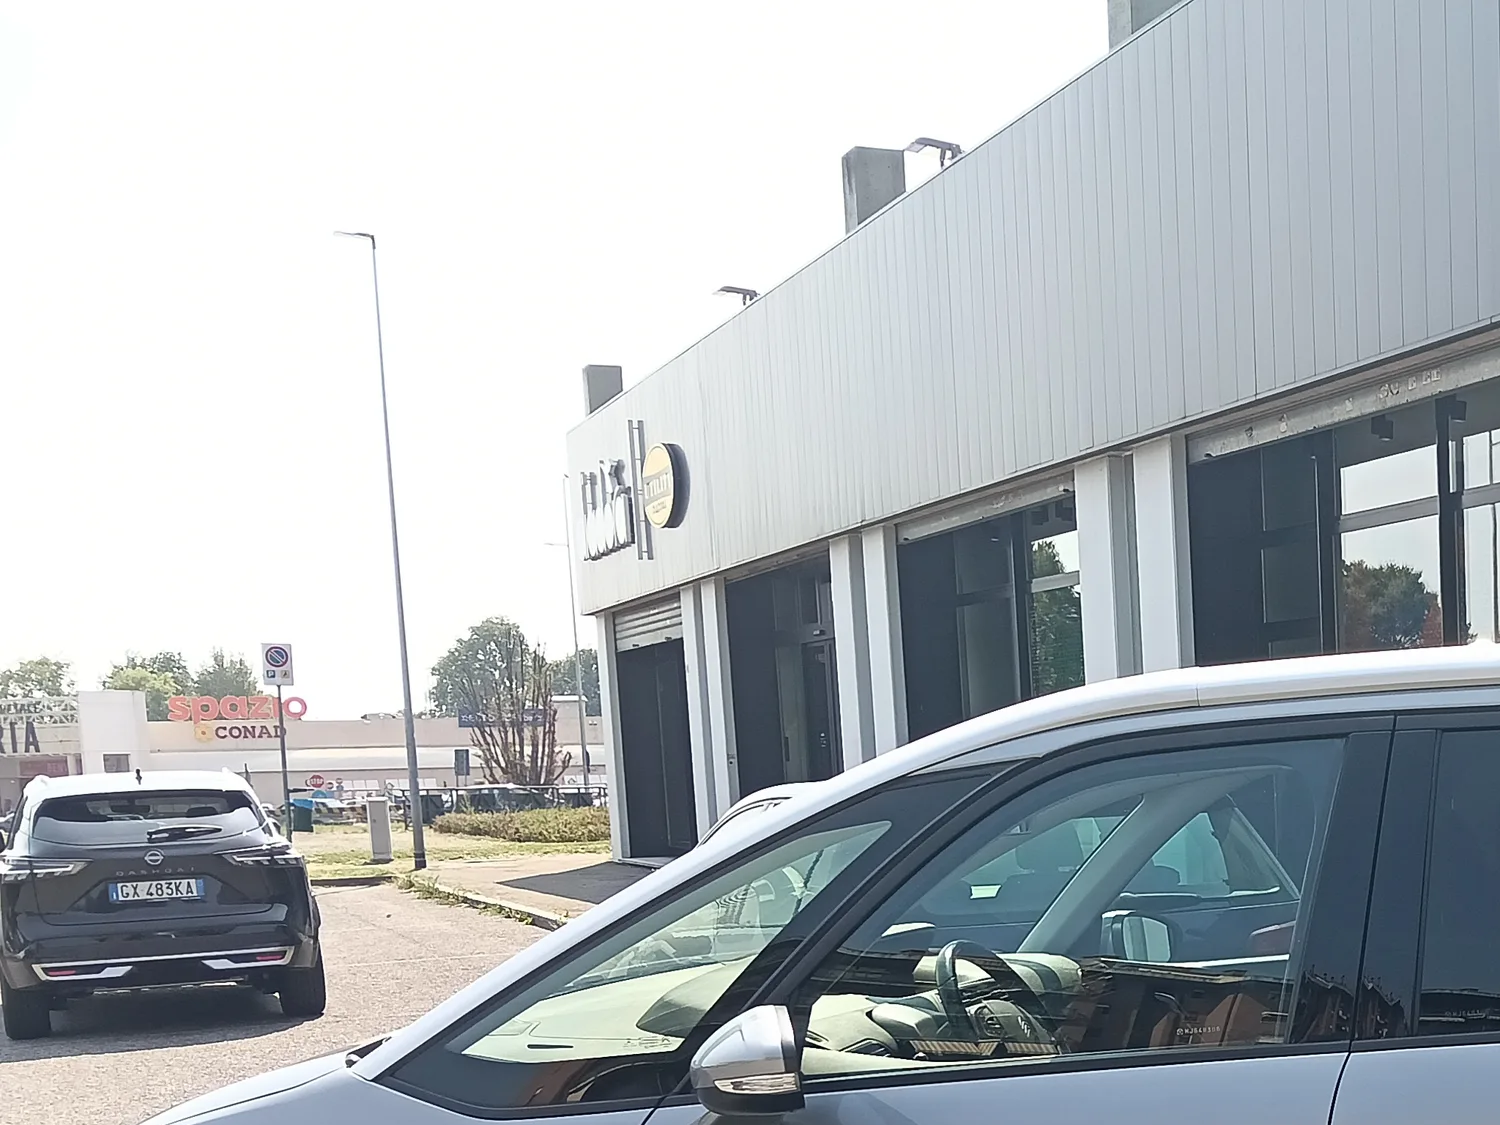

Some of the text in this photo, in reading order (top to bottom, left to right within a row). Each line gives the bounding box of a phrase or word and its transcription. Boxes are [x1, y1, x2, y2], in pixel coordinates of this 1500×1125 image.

[168, 695, 307, 724] spazio
[215, 725, 286, 739] CONAD
[120, 884, 140, 899] GX
[146, 881, 194, 897] 483KA
